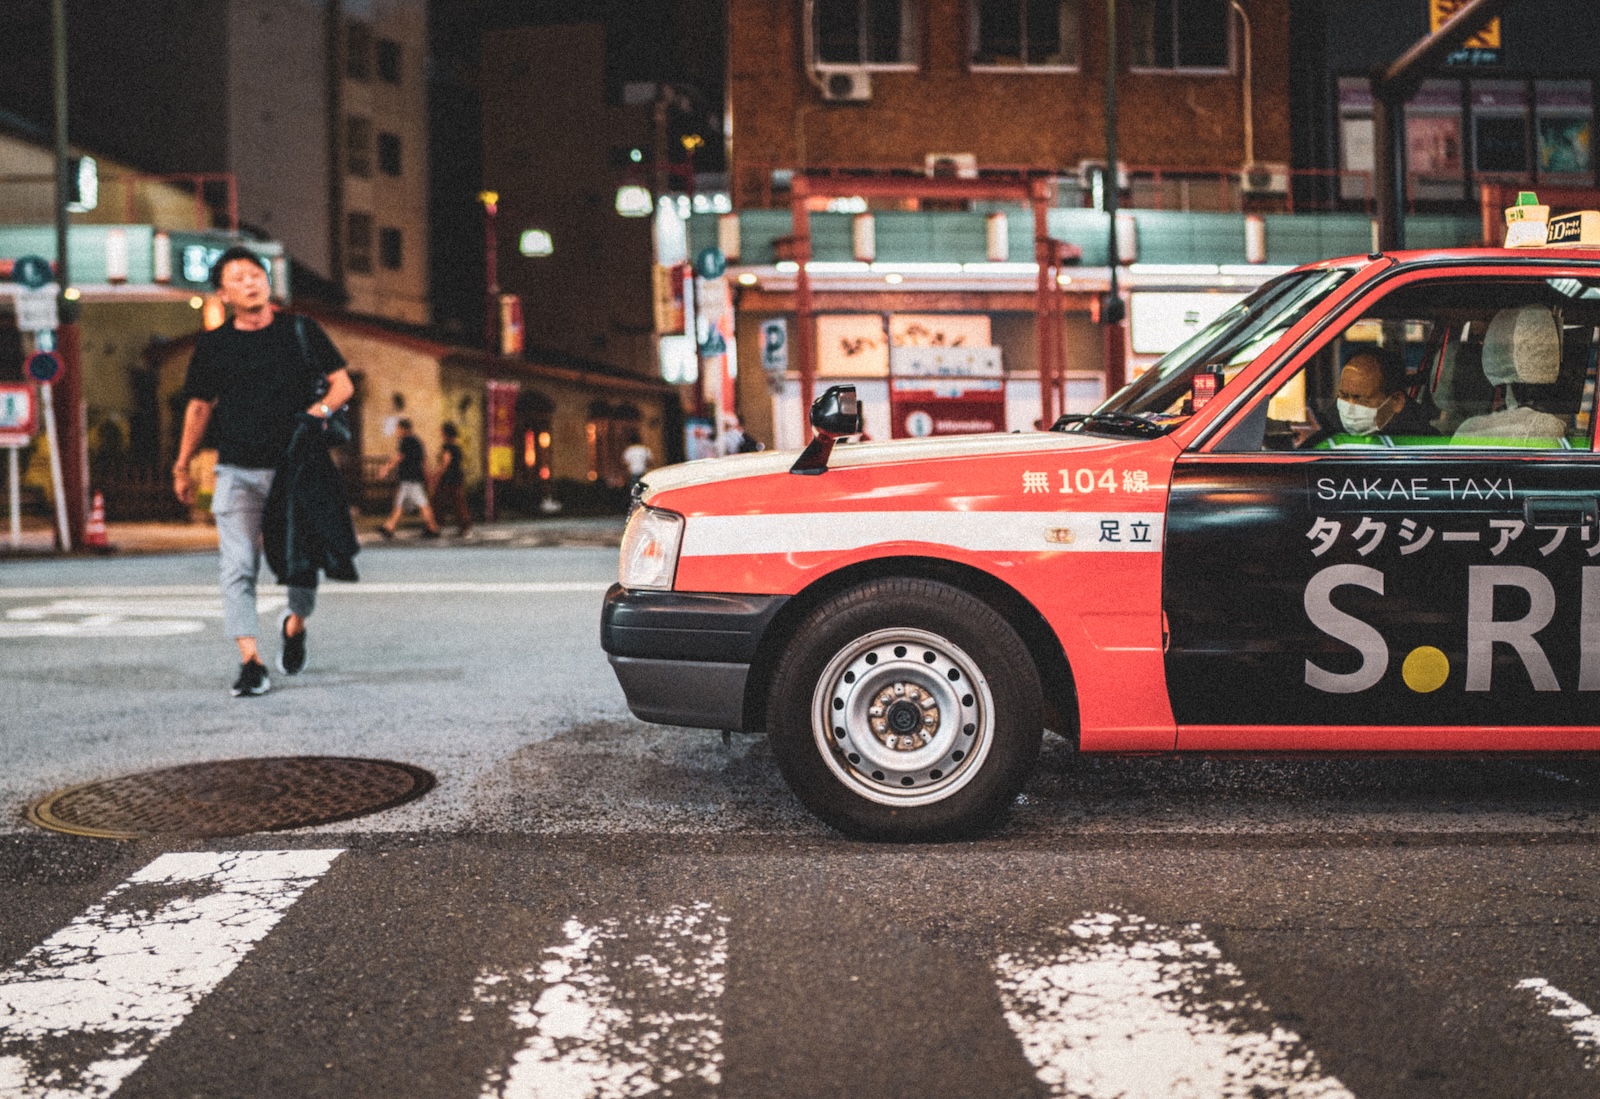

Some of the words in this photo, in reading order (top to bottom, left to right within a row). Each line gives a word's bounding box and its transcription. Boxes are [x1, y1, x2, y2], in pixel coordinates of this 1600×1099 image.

[1316, 477, 1431, 500] SAKAE
[1441, 477, 1514, 500] TAXI
[1098, 520, 1152, 543] 足立
